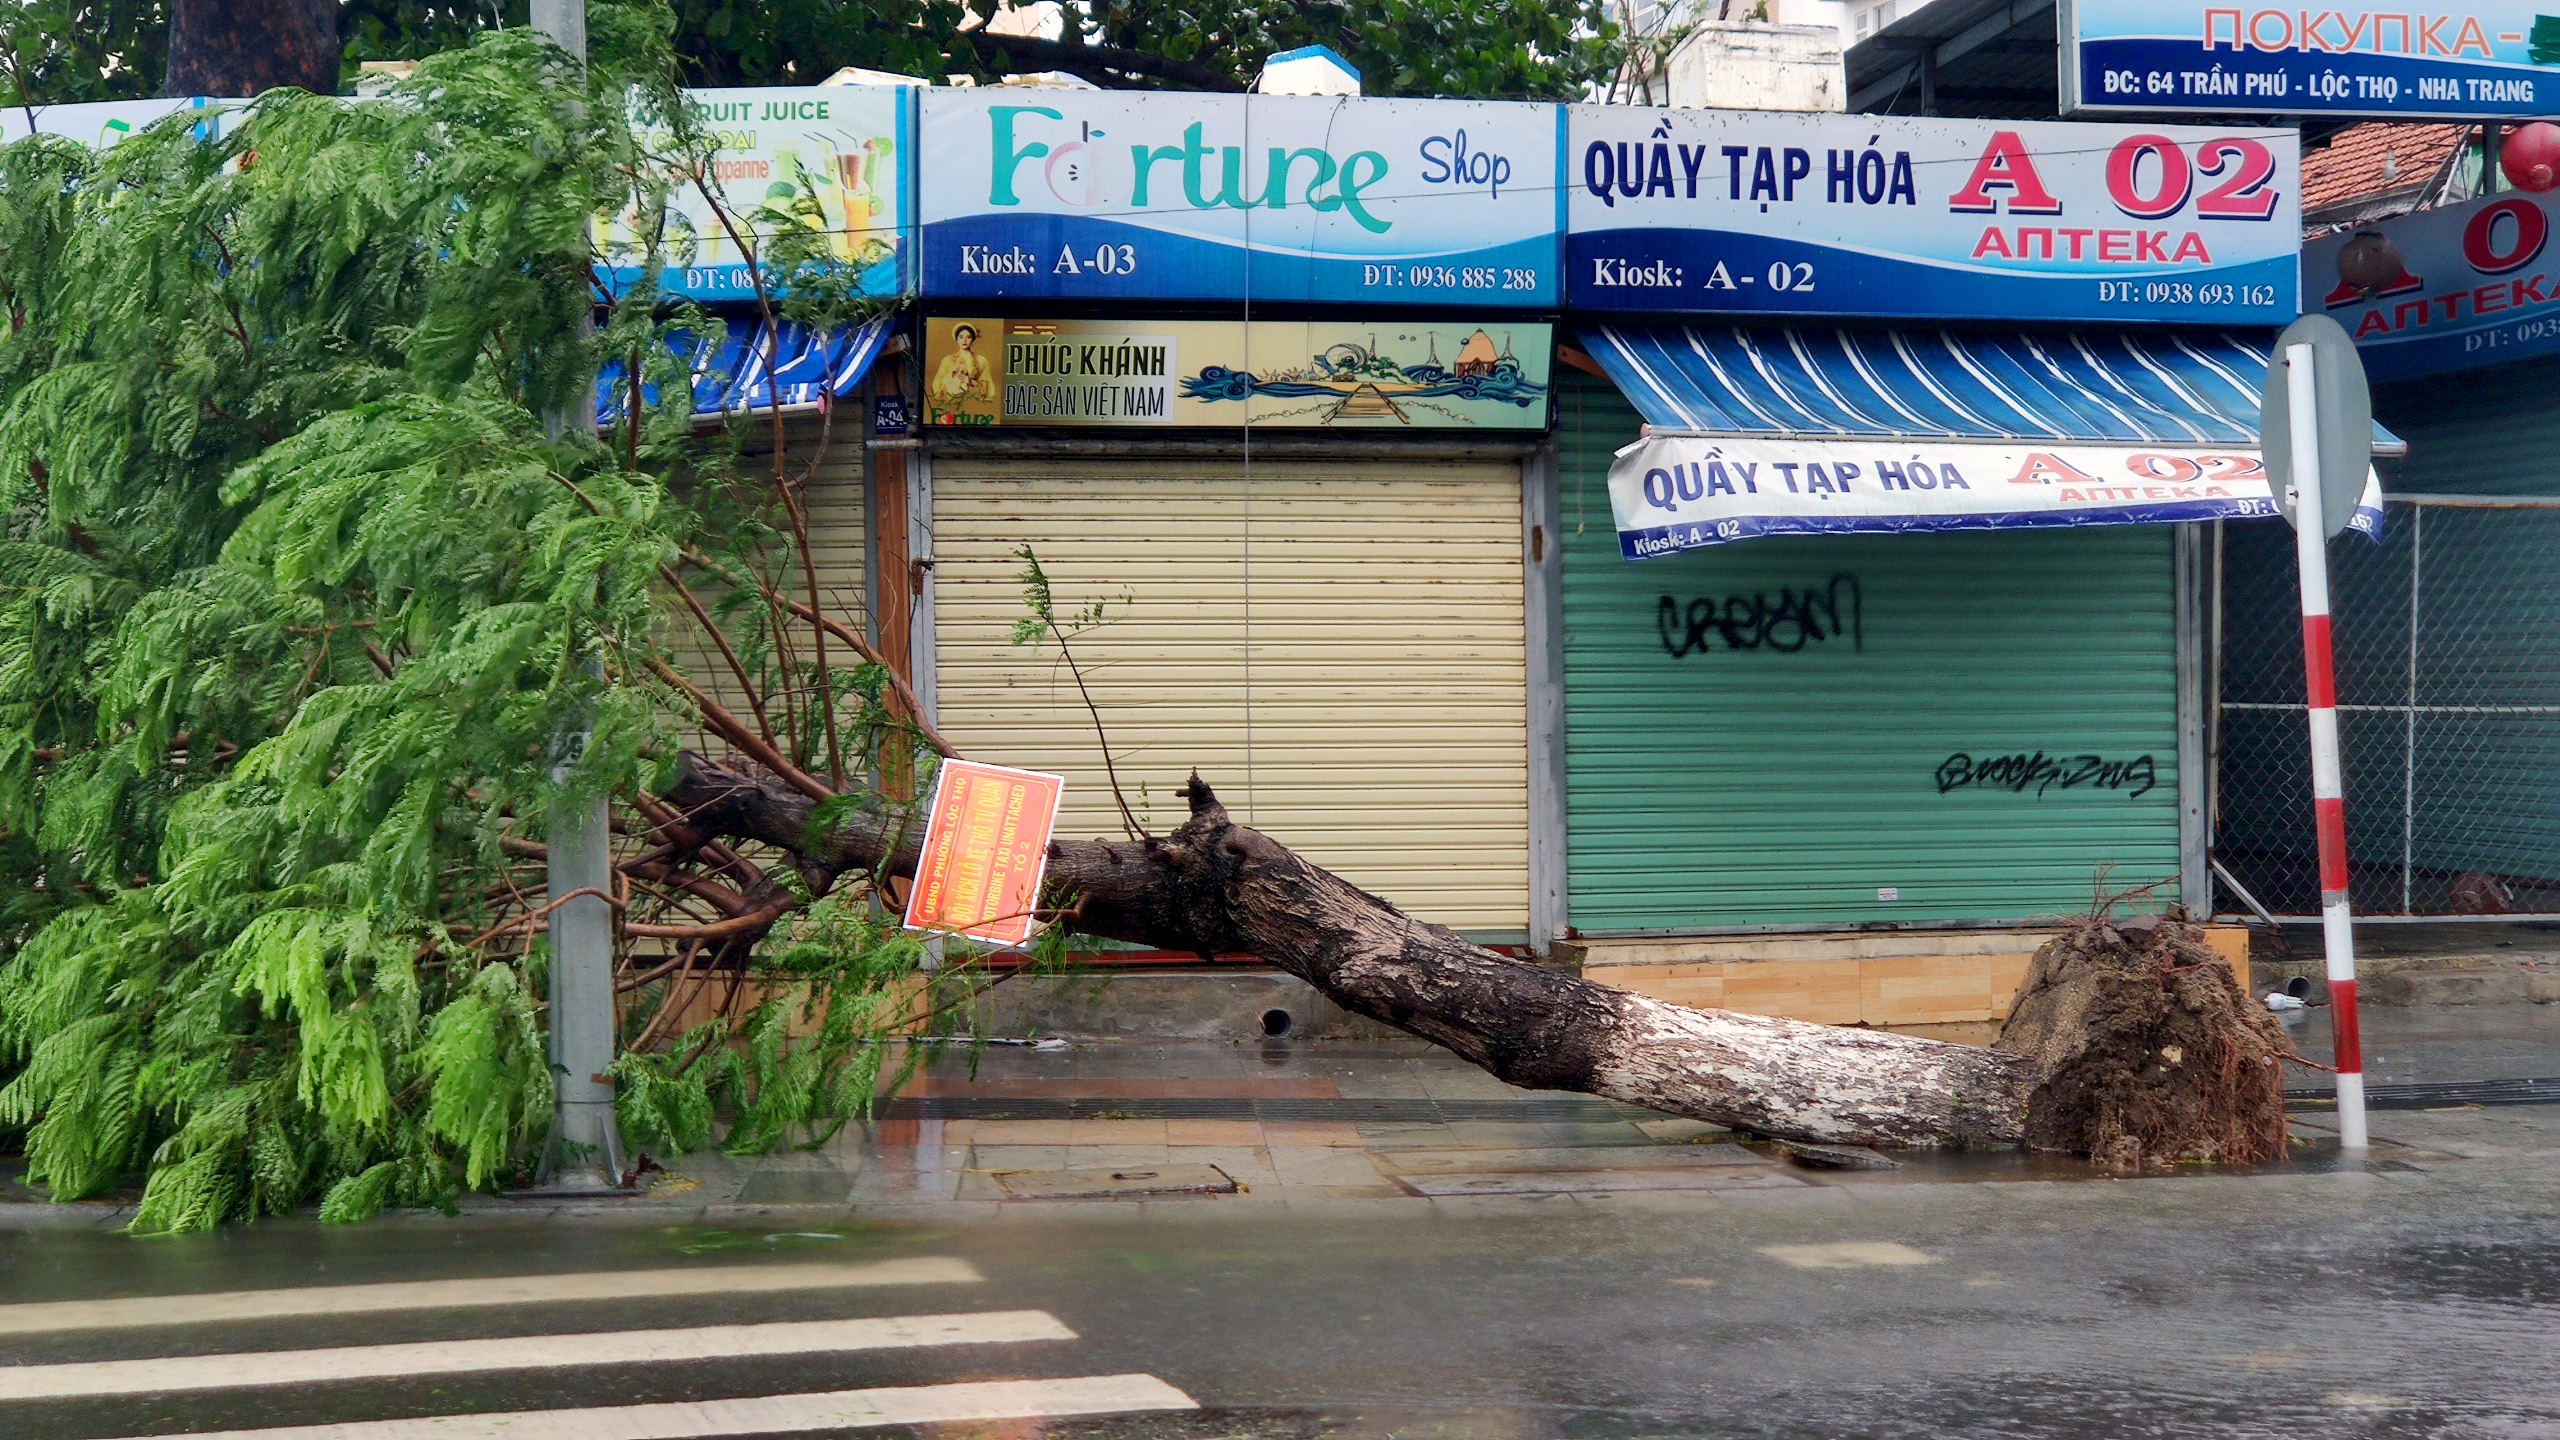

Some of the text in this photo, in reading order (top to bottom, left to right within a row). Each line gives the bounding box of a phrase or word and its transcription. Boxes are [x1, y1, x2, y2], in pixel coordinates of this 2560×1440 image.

[2104, 69, 2140, 93] ĐC:
[2147, 71, 2174, 94] 64
[2180, 63, 2238, 95] TRẦN
[2245, 67, 2287, 96] PHÚ
[2309, 69, 2350, 101] LỘC
[2356, 76, 2397, 103] THỌ
[2419, 78, 2461, 100] NHA
[2466, 79, 2534, 103] TRANG
[699, 101, 830, 122] RUIT JUICE
[1420, 128, 1511, 199] Shop
[1584, 118, 1917, 213] QUẦY TẠP HÓA
[2105, 134, 2280, 221] 02
[960, 244, 1036, 275] Kiosk:
[1970, 226, 2214, 265] АПТЕКА
[686, 269, 725, 289] ĐT:
[1363, 264, 1536, 291] ĐT: 0936 885 288
[1593, 258, 1682, 287] Kiosk:
[1768, 262, 1815, 292] 02
[2099, 281, 2275, 306] ĐT: 0938 693 162
[2354, 274, 2560, 340] АПТЕК
[2517, 318, 2560, 342] 093
[1006, 336, 1166, 378] PHÚC KHÁNH
[1005, 378, 1164, 419] ĐẶC SẢN VIỆT NAM
[1643, 446, 1971, 512] QUẦY TẠP HÓA
[2060, 486, 2232, 502] АПТЕКА
[2238, 500, 2268, 514] ĐT:
[1634, 532, 1685, 555] Kiosk:
[952, 777, 967, 801] THỌ
[945, 803, 960, 827] LỘC
[1000, 784, 1026, 845] UNATTACHED
[965, 847, 989, 862] XE
[995, 847, 1012, 868] TAXI
[1020, 841, 1031, 851] 2
[924, 881, 940, 914] UBND
